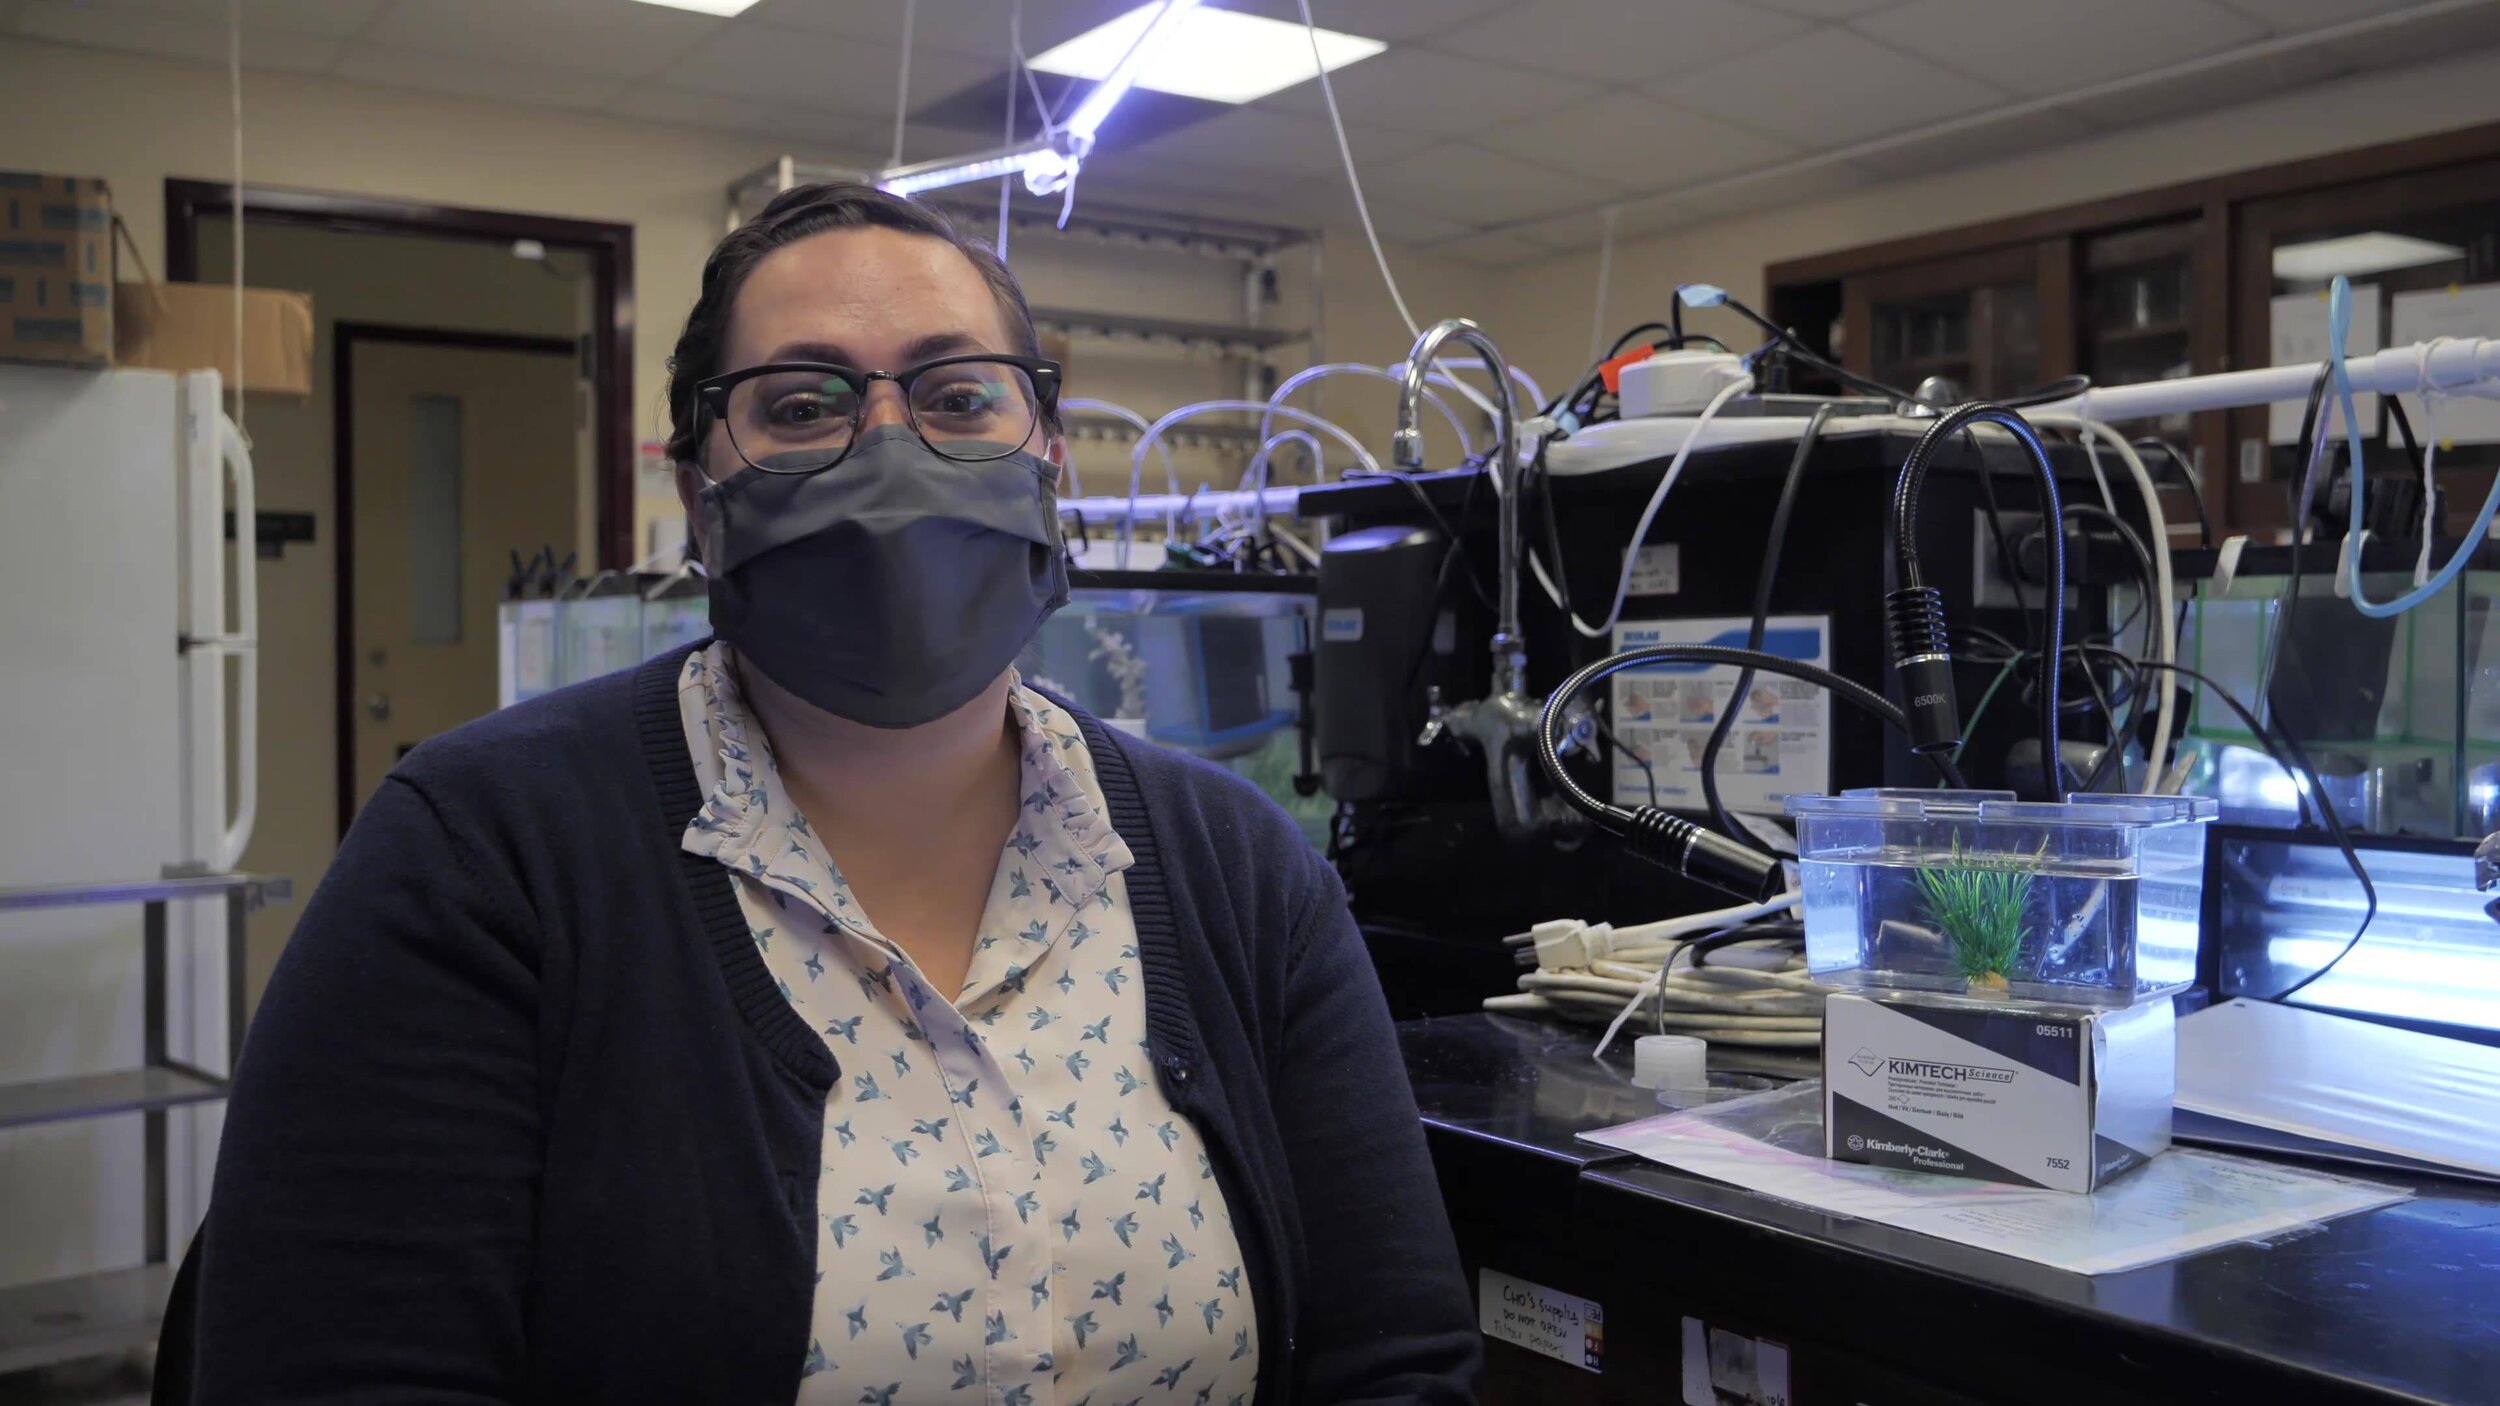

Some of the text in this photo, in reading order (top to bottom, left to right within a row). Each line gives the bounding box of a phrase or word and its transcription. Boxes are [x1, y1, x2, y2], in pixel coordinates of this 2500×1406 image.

[1914, 693, 1946, 707] 6500K
[2036, 1024, 2073, 1039] 05511
[1888, 1060, 2011, 1082] KIMTECH Science
[1866, 1138, 1948, 1159] Kimberly-Clark
[1913, 1156, 1964, 1171] Professional
[2046, 1157, 2070, 1170] 7552
